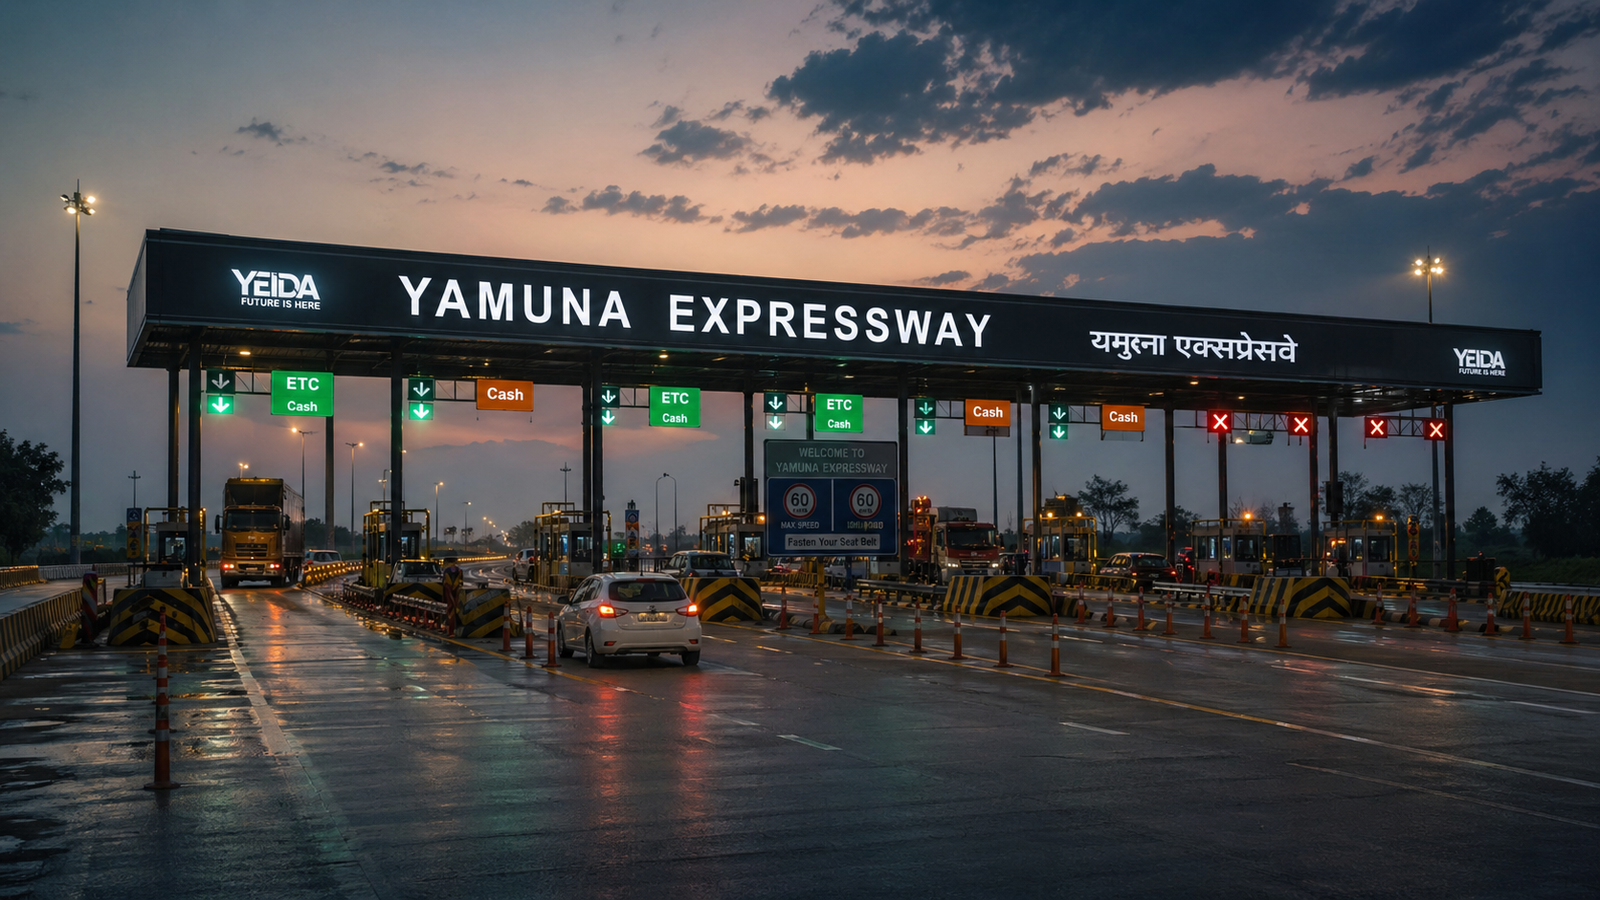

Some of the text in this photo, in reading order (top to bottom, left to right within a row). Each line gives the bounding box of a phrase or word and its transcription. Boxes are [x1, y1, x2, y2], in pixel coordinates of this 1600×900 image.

[231, 268, 321, 300] YEIDA
[241, 297, 321, 310] FUTURE IS HERE
[398, 275, 991, 348] YAMUNA EXPRESSWAY
[1173, 331, 1299, 363] एक्सप्रेसवे
[1453, 347, 1506, 369] YEIDA
[1458, 367, 1482, 375] FUTURE
[1490, 369, 1506, 377] HERE
[286, 376, 320, 391] ETC
[487, 387, 524, 401] Cash
[661, 391, 689, 405] ETC
[287, 400, 318, 412] Cash
[826, 398, 852, 411] ETC
[662, 412, 688, 424] Cash
[973, 405, 1003, 419] Cash
[1109, 410, 1138, 423] Cash
[827, 418, 851, 430] Cash
[799, 447, 865, 459] WELCOME TO
[776, 462, 888, 474] YAMUNA EXPRESSWAY
[790, 492, 809, 507] 60
[856, 493, 874, 507] 60
[781, 521, 796, 529] MAX
[788, 537, 877, 547] Fasten Your Seat Belt
